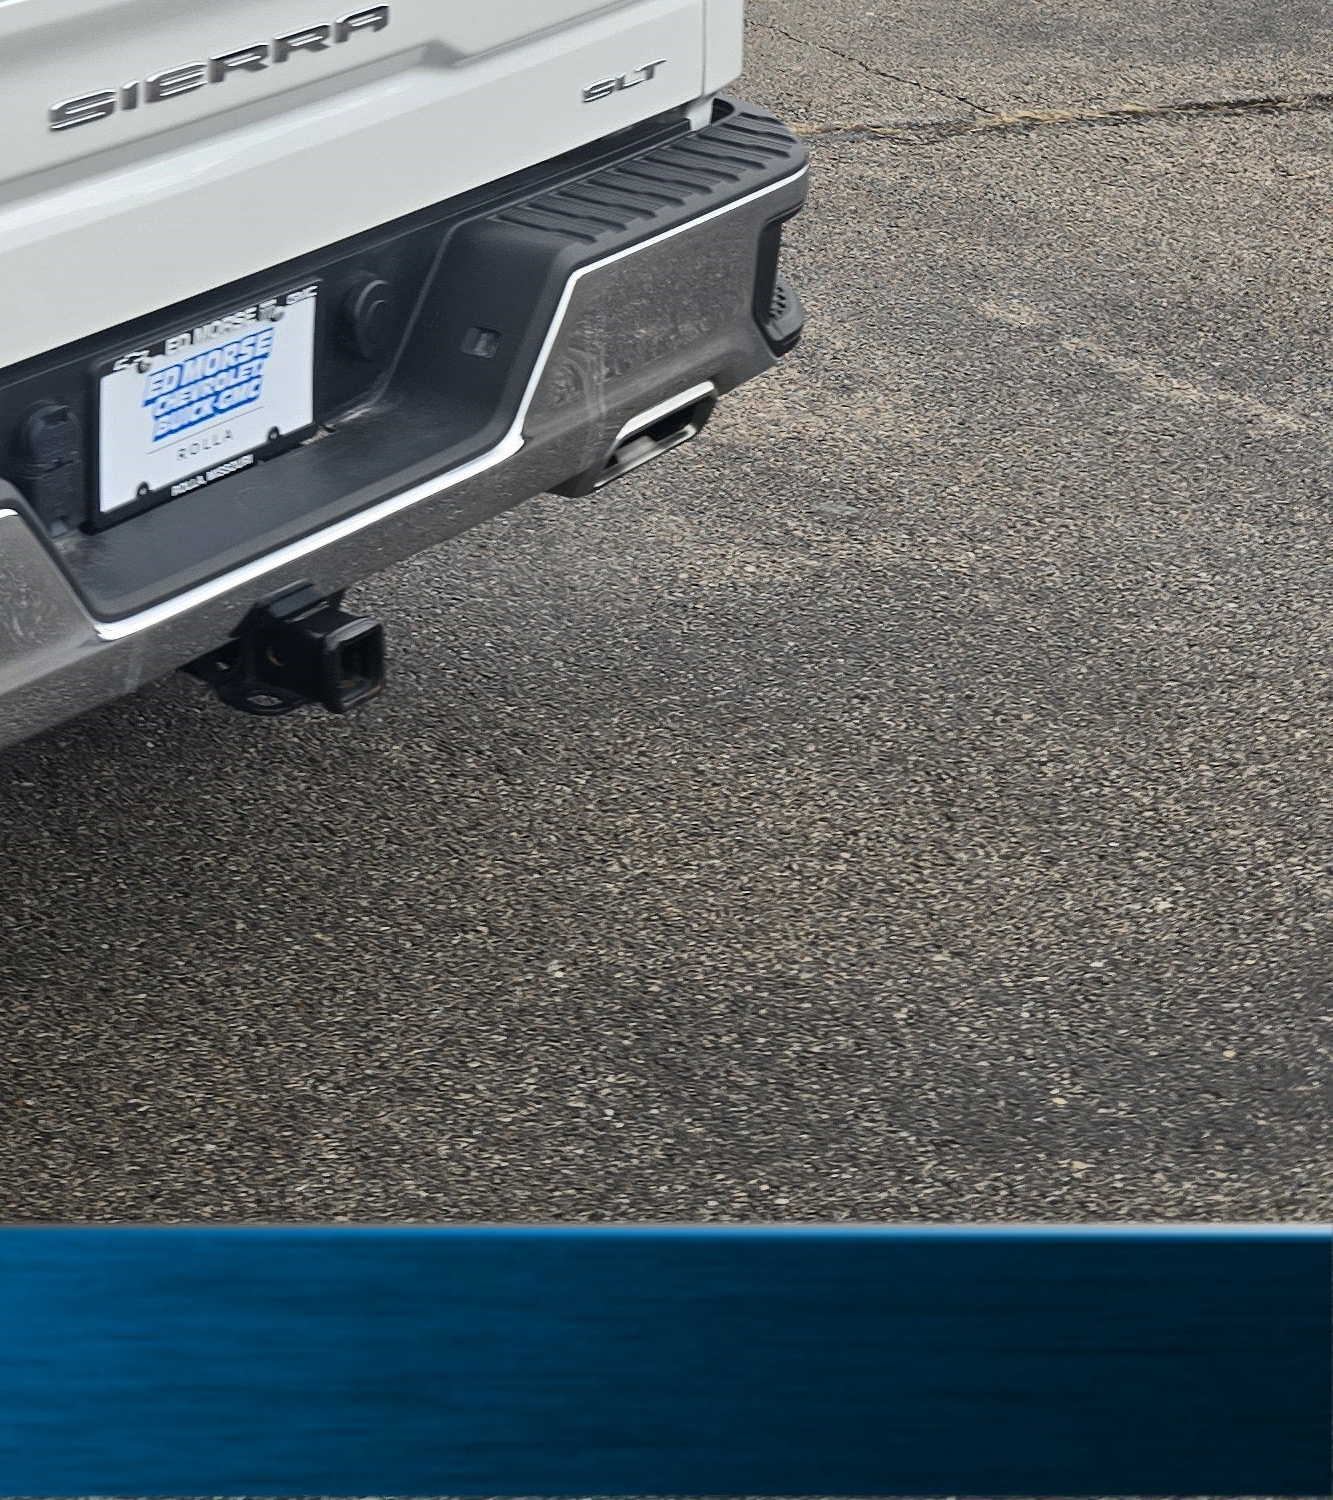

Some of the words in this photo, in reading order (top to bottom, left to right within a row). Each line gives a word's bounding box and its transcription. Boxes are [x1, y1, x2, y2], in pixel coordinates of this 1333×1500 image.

[49, 3, 390, 132] SIERRA
[583, 58, 667, 103] SLT
[144, 365, 181, 400] ED
[183, 329, 273, 383] MORSE
[176, 429, 234, 460] ROLLA
